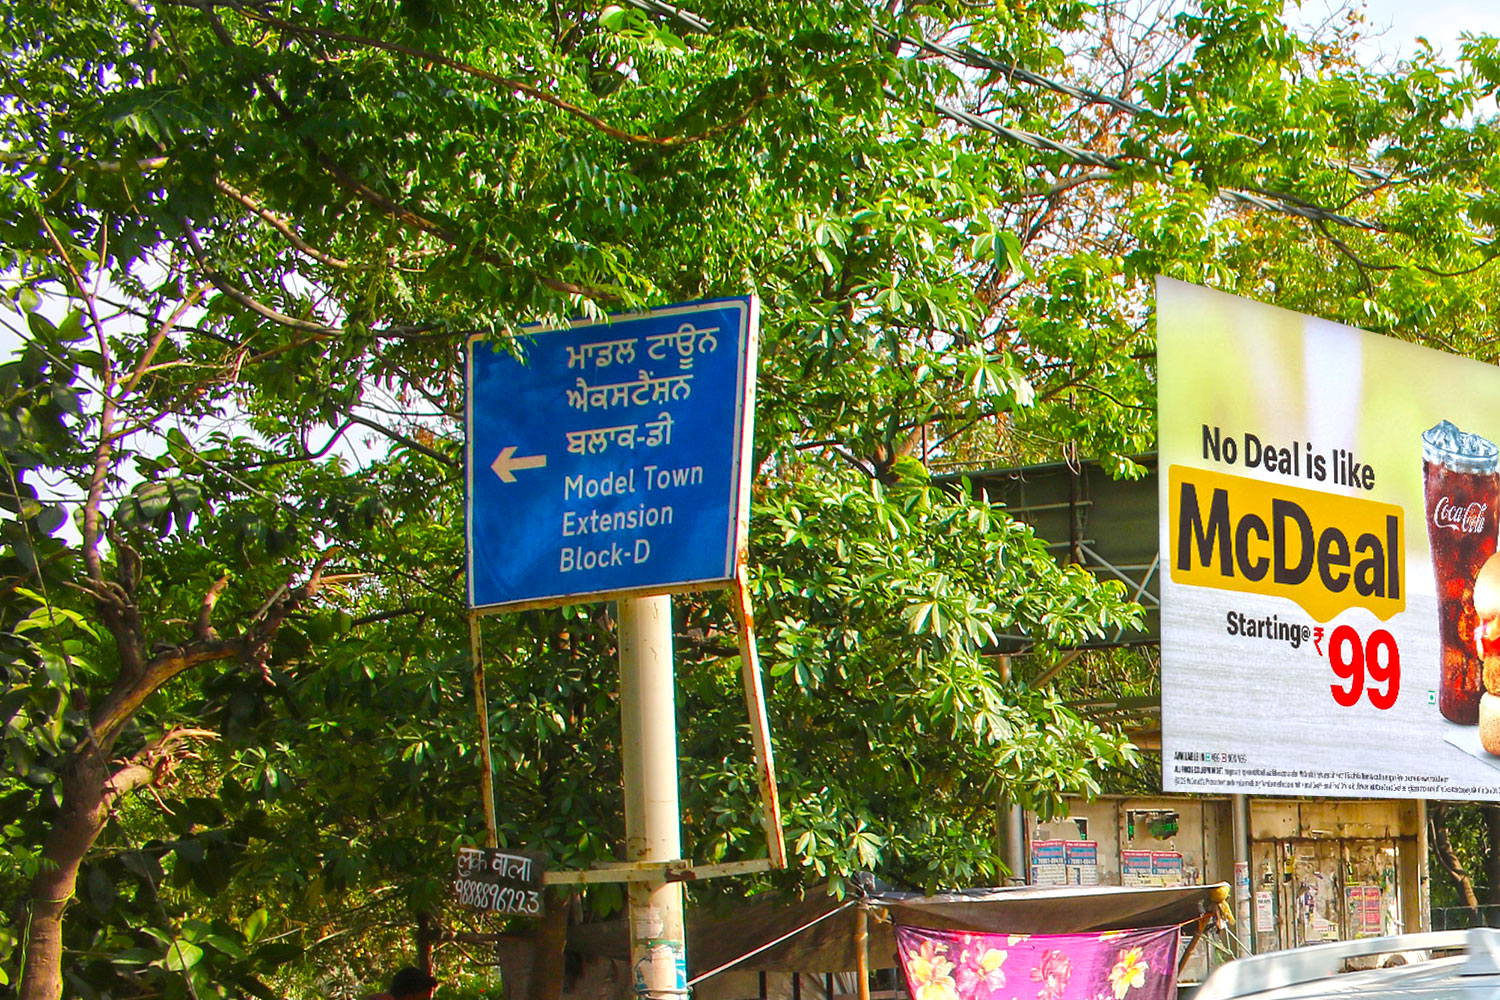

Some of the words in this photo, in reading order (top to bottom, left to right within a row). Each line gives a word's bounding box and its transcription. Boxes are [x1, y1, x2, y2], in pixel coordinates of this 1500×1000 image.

[566, 338, 638, 369] ਮਾਡਲ
[646, 323, 720, 369] ਟਾਊਨ
[566, 412, 675, 455] ਬਲਾਕ-ਡੀ
[1202, 424, 1238, 464] No
[1244, 433, 1300, 477] Deal
[1306, 442, 1327, 482] is
[1333, 449, 1376, 491] like
[563, 468, 635, 501] Model
[644, 464, 704, 489] Town
[561, 503, 673, 537] Extension
[559, 539, 651, 573] Block-D
[1177, 482, 1400, 600] McDeal
[492, 853, 532, 882] वाला
